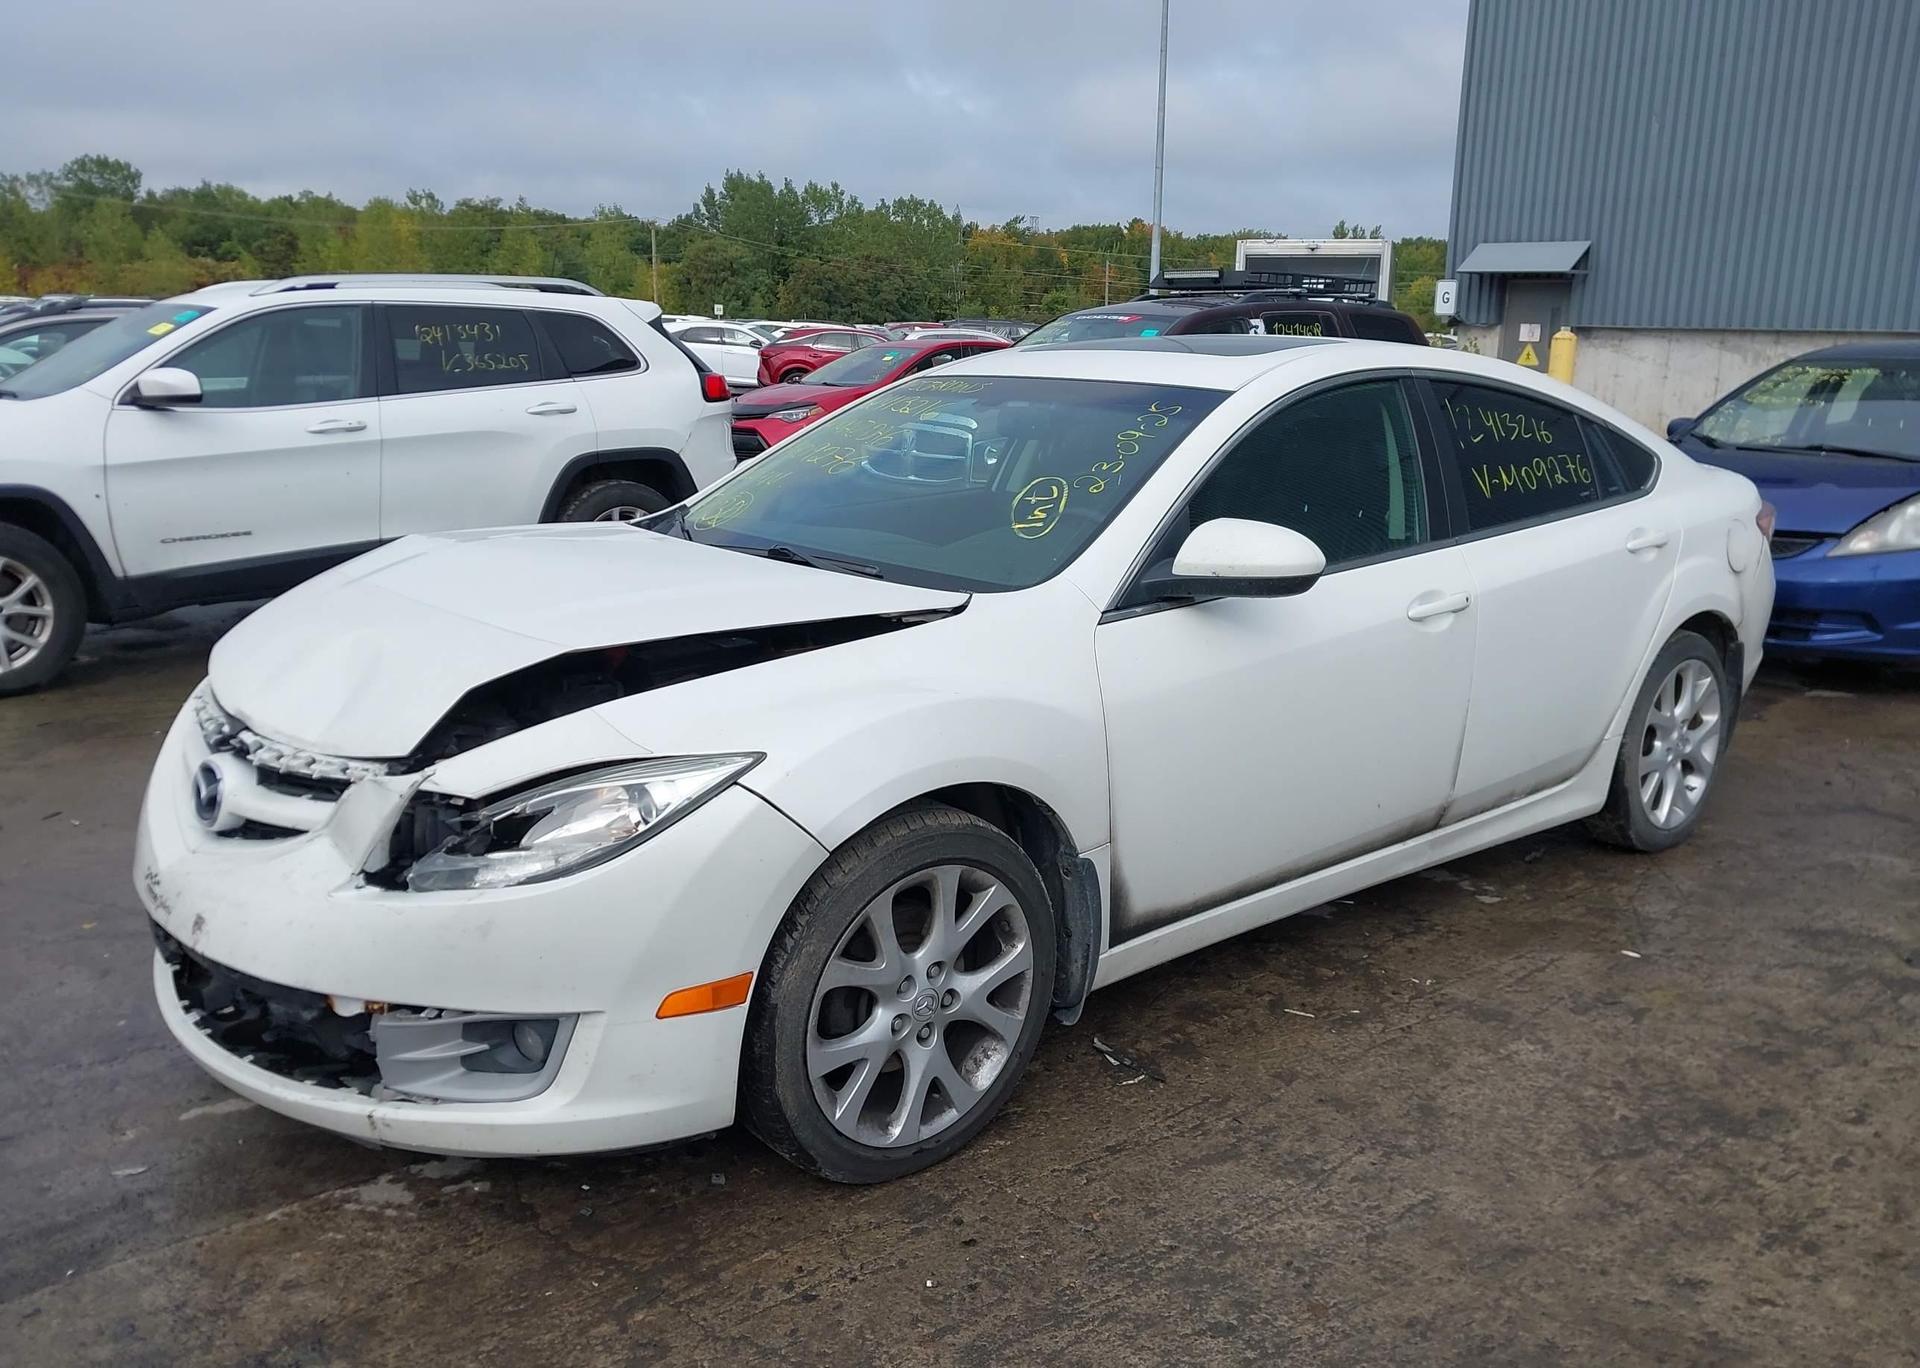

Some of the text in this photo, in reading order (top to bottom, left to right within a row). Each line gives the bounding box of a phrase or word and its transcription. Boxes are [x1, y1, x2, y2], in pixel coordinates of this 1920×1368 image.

[1442, 291, 1450, 304] G
[1445, 397, 1553, 449] 12413216
[1072, 400, 1183, 494] 23-09-25
[1471, 454, 1592, 499] V-M09276
[160, 530, 253, 544] CHEROKEE
